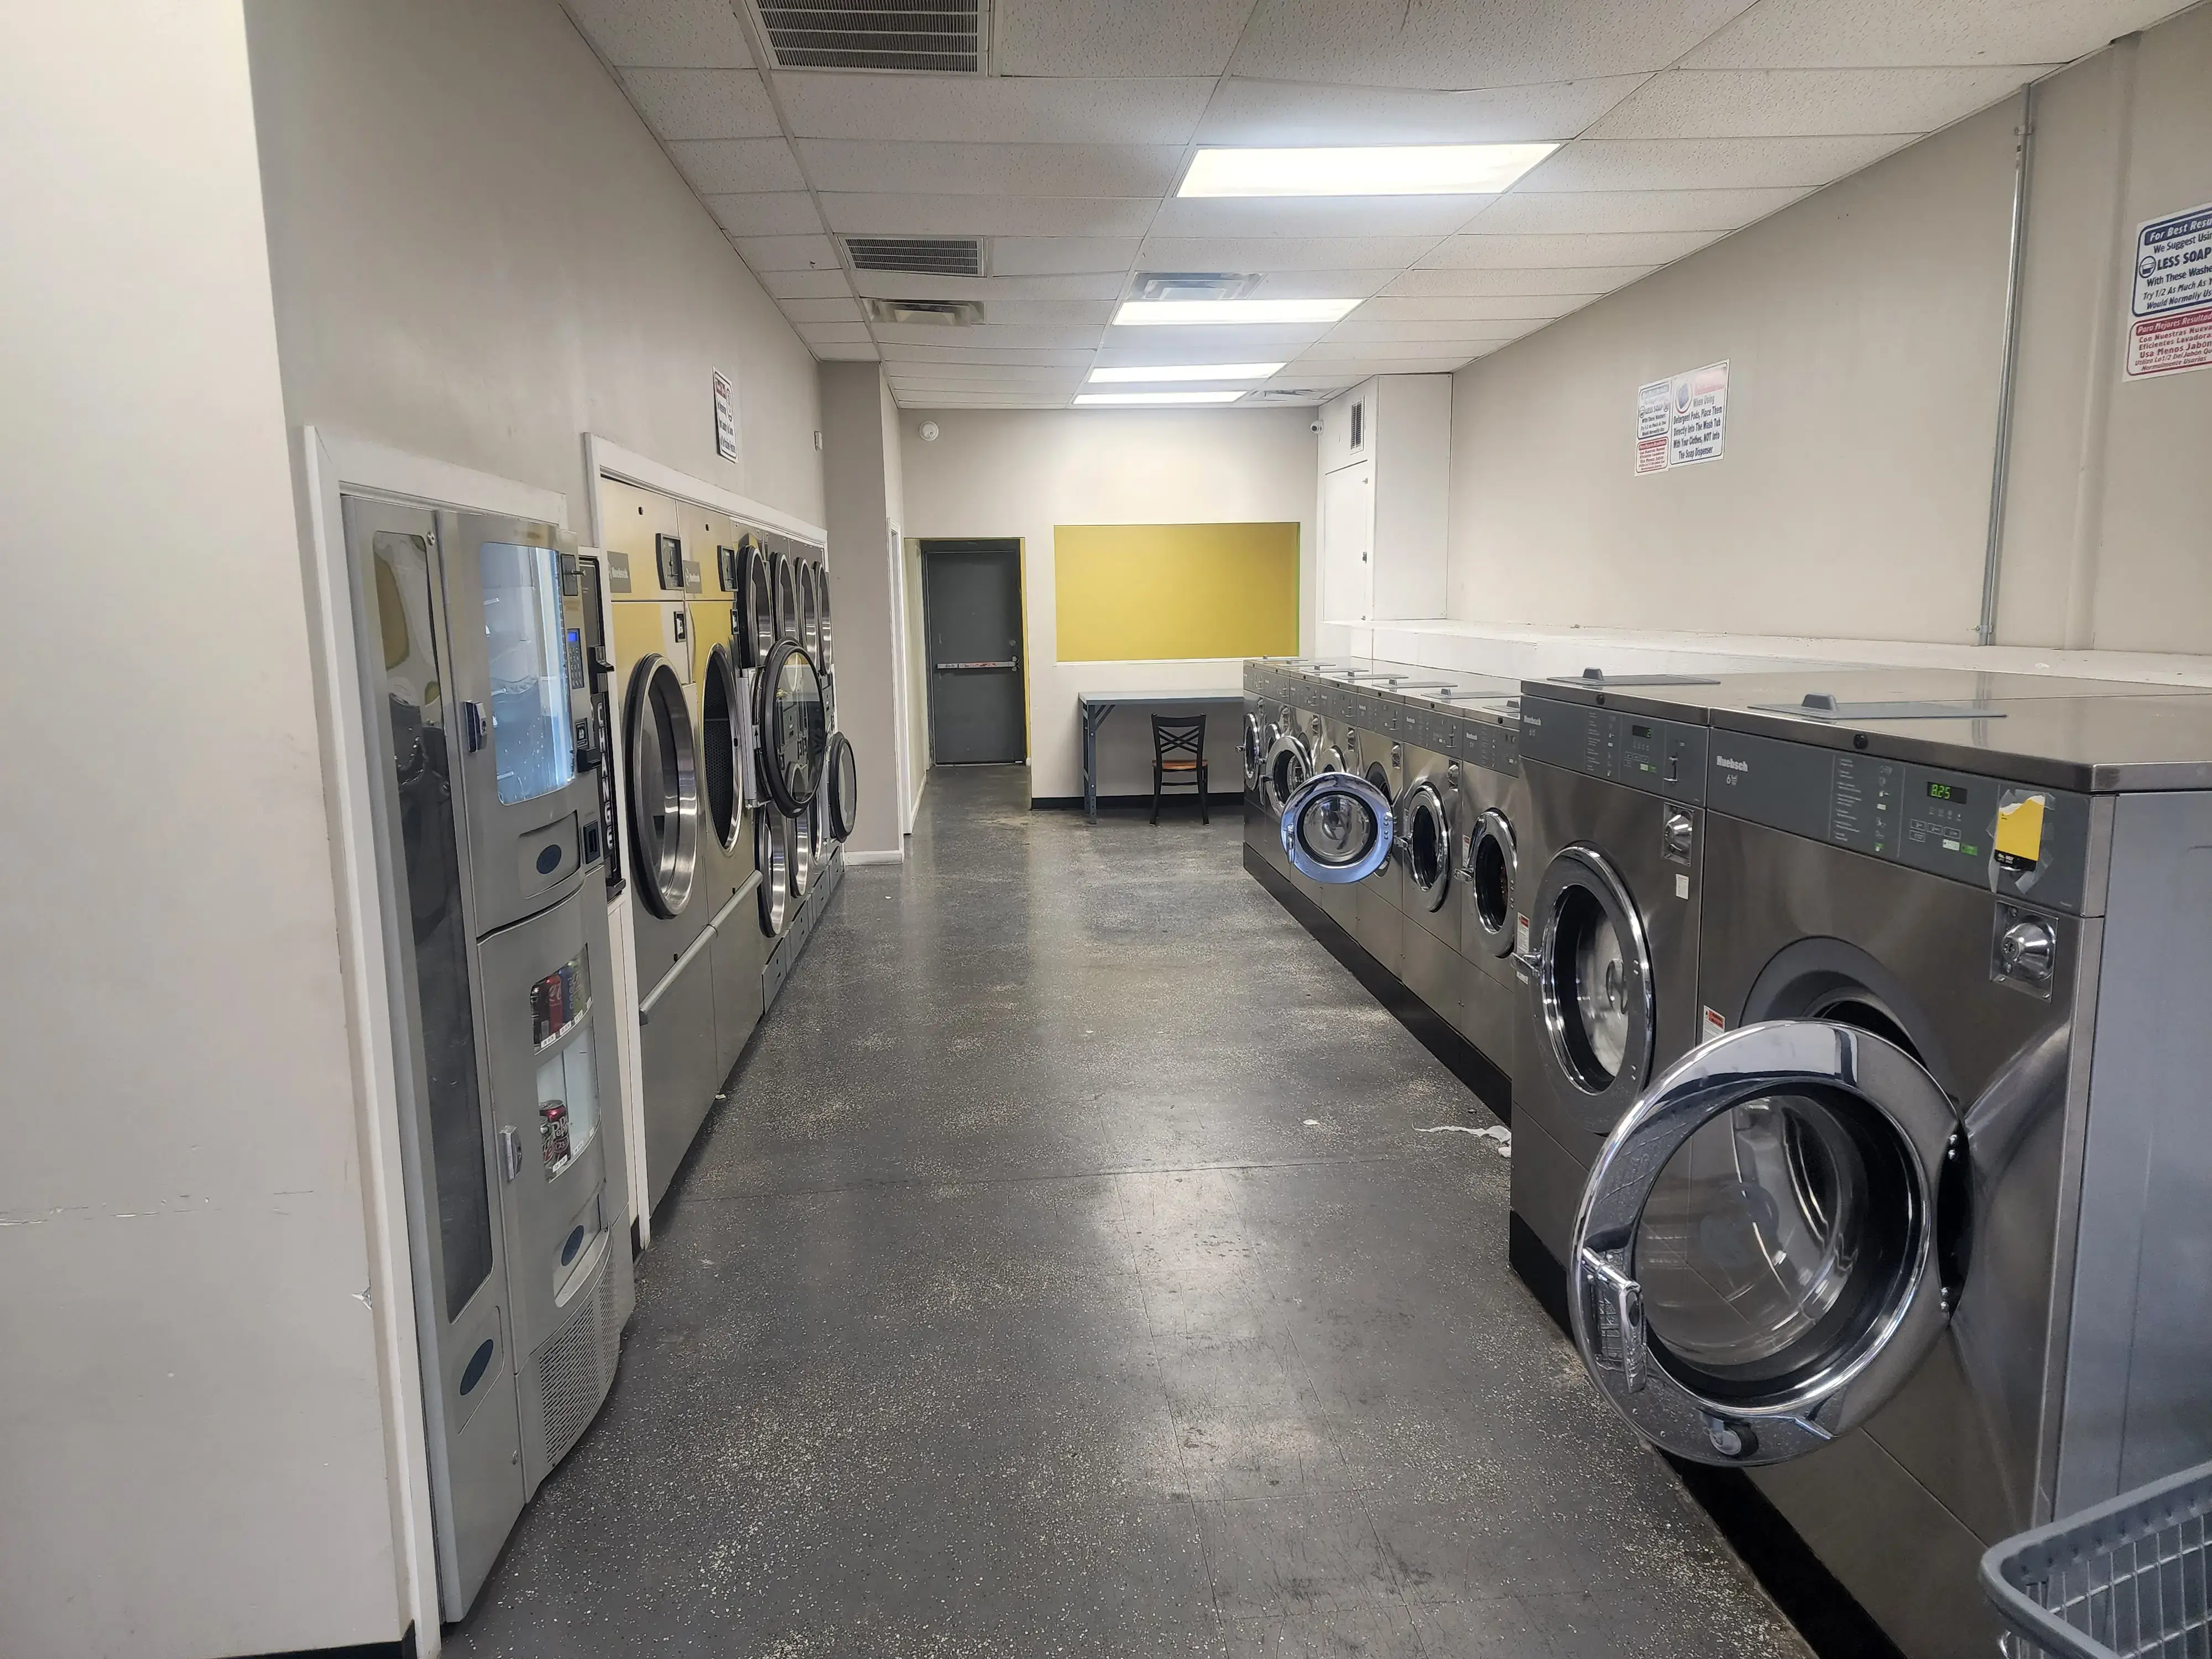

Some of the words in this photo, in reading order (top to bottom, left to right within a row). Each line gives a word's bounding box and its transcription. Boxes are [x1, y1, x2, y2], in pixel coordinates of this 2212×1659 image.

[2150, 230, 2164, 242] For
[2167, 223, 2188, 237] Best
[2153, 244, 2165, 254] We
[2167, 236, 2196, 251] Suggest
[2157, 254, 2180, 270] LESS
[2183, 247, 2212, 264] SOAP
[2147, 276, 2164, 287] With
[2166, 272, 2187, 282] These
[2143, 291, 2154, 300] Try
[2155, 288, 2166, 297] 1/2
[2168, 286, 2176, 294] As
[2178, 281, 2195, 292] Much
[2197, 279, 2206, 288] As
[2147, 299, 2167, 310] Would
[2169, 291, 2202, 305] Normally
[2154, 319, 2180, 331] Mejores
[2154, 329, 2187, 340] Nuestras
[2139, 340, 2174, 350] Eficientes
[2157, 346, 2184, 356] Menos
[1701, 408, 1711, 418] Place
[1712, 405, 1722, 415] Them
[1703, 419, 1713, 430] Wash
[1703, 431, 1712, 442] NOT
[1686, 449, 1694, 459] Soap
[1695, 447, 1713, 457] Dispenser
[597, 702, 613, 851] CHANGE
